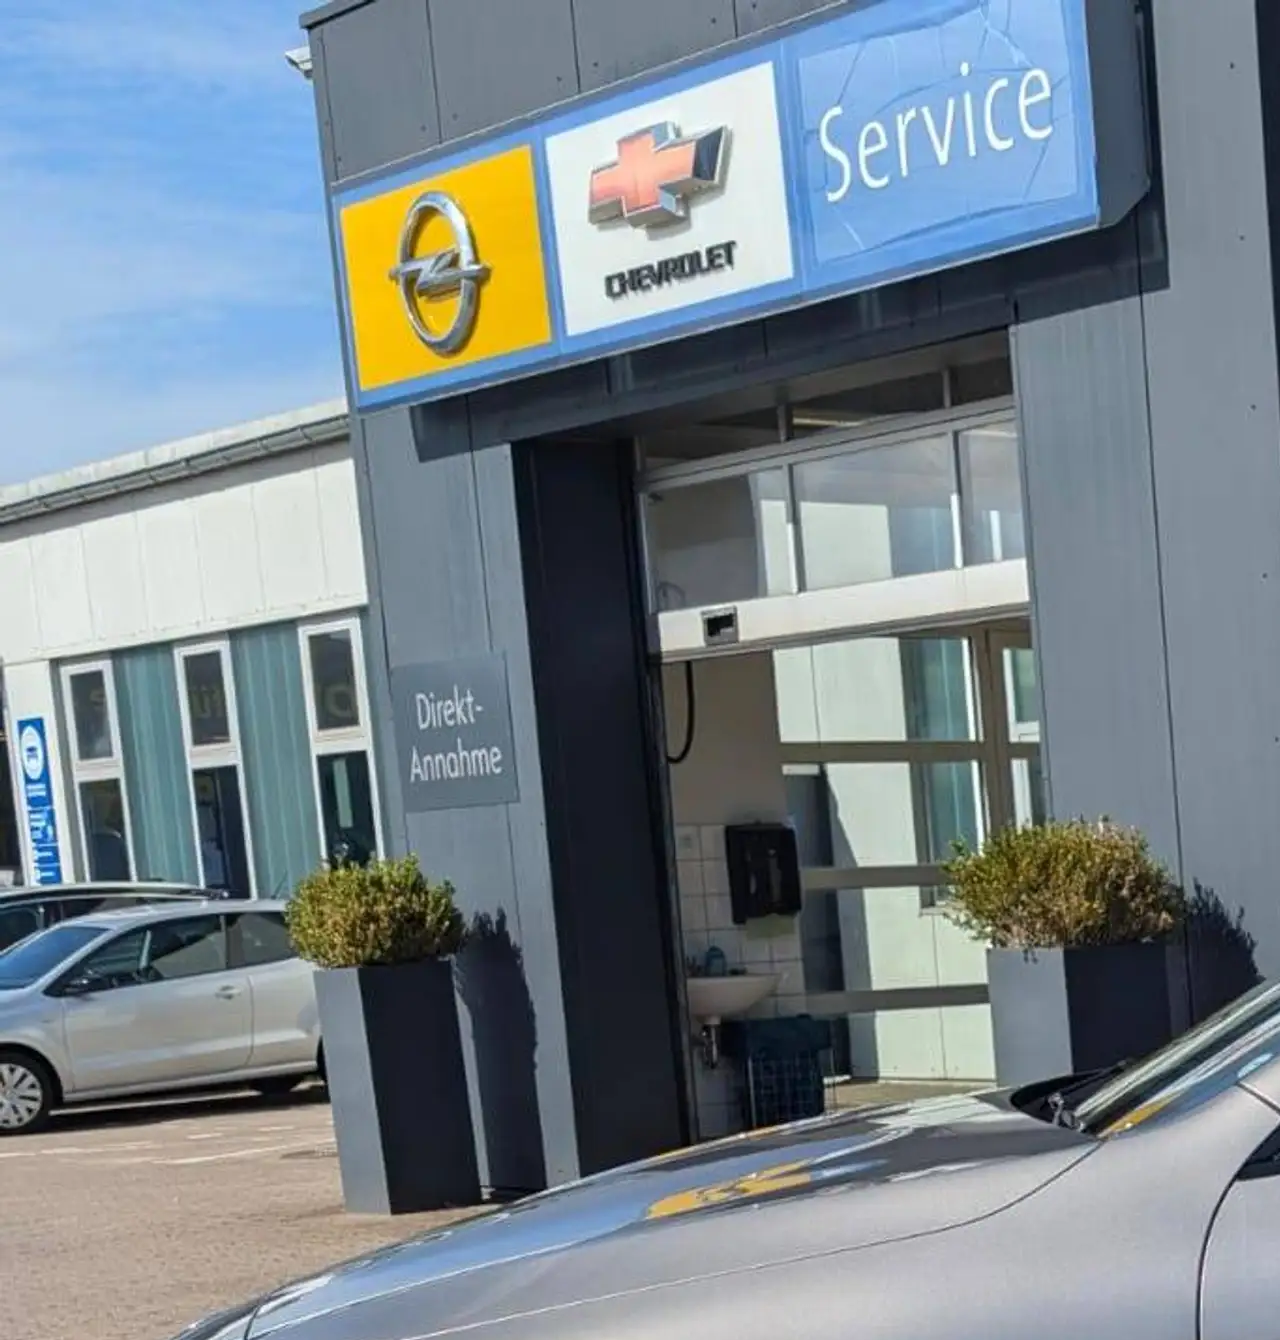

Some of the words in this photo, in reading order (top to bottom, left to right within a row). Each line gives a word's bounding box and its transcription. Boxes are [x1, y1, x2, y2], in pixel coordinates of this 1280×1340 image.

[819, 62, 1053, 202] Service
[604, 240, 737, 299] CHEVROLET
[416, 684, 483, 730] Direkt-
[410, 736, 503, 783] Annahme
